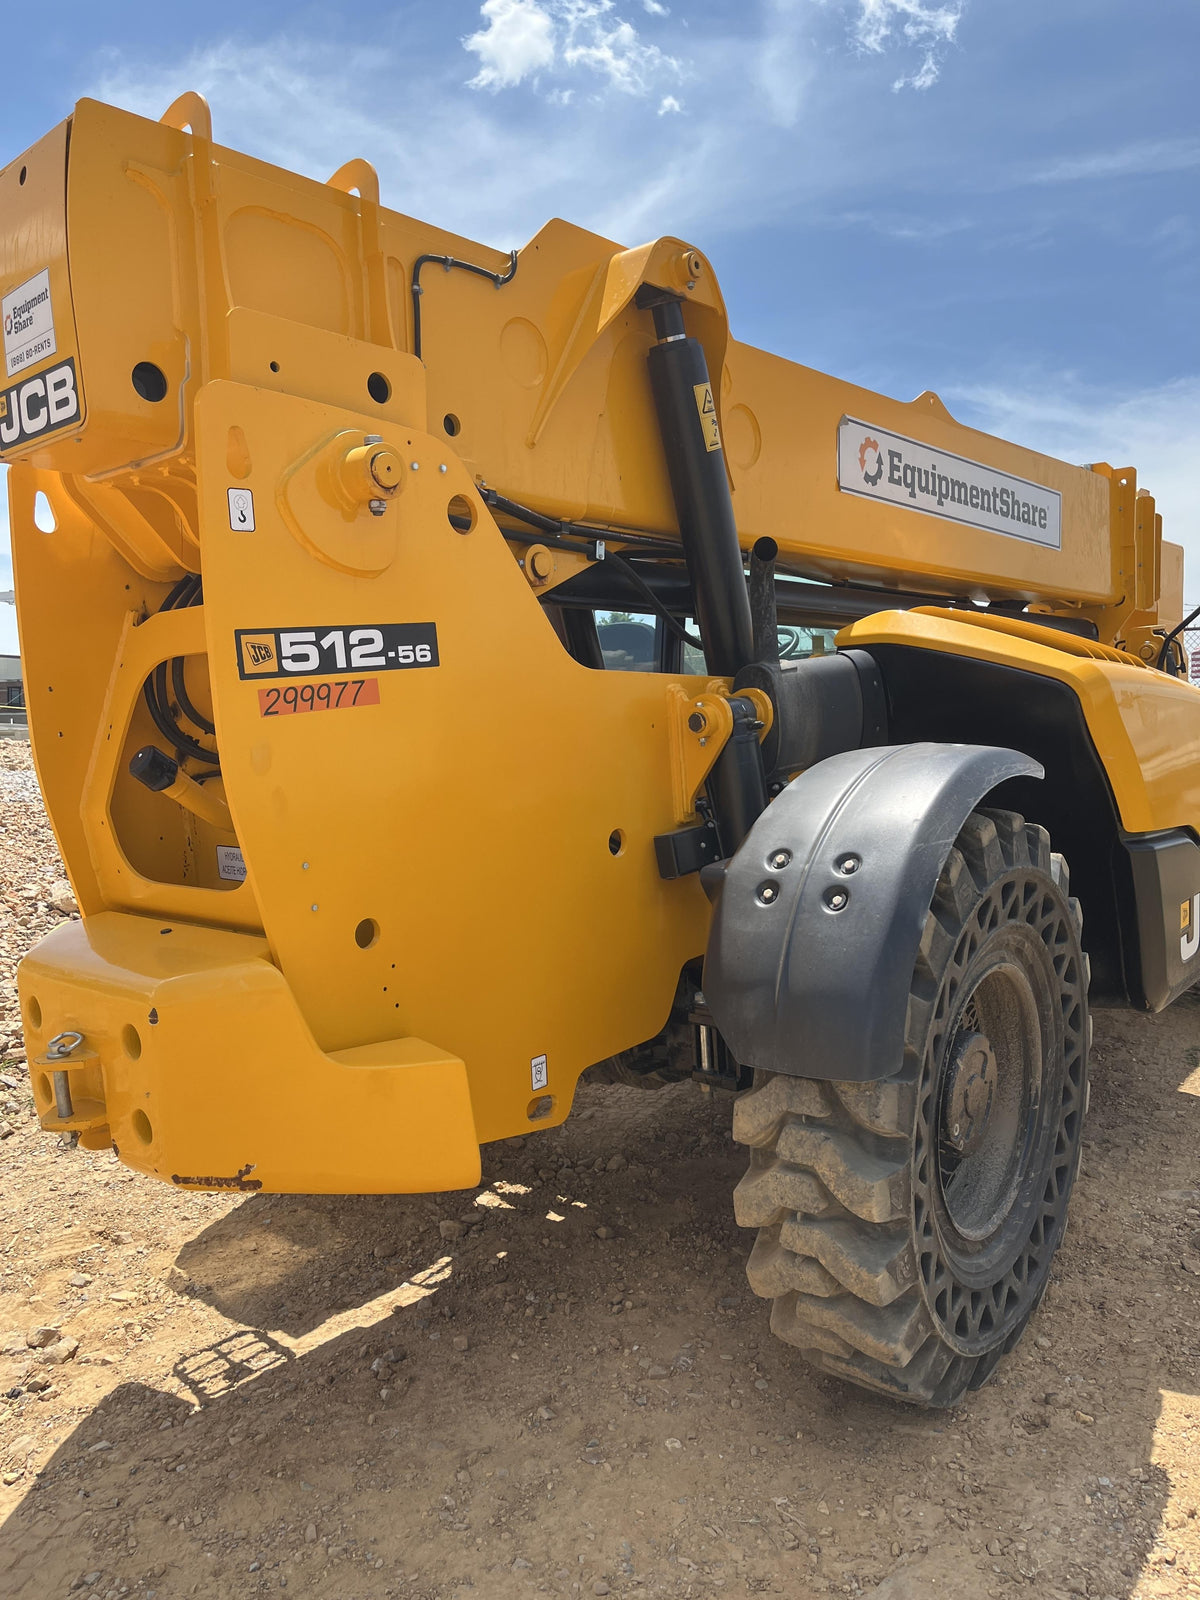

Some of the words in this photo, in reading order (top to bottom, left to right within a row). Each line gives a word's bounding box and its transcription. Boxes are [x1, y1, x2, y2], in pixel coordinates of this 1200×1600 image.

[12, 287, 49, 320] Equipment
[13, 314, 34, 335] Share
[0, 365, 78, 444] JCB
[887, 448, 1048, 530] EquipmentShare
[250, 644, 273, 664] JCB
[279, 628, 432, 672] 512-56
[263, 679, 366, 716] 299977
